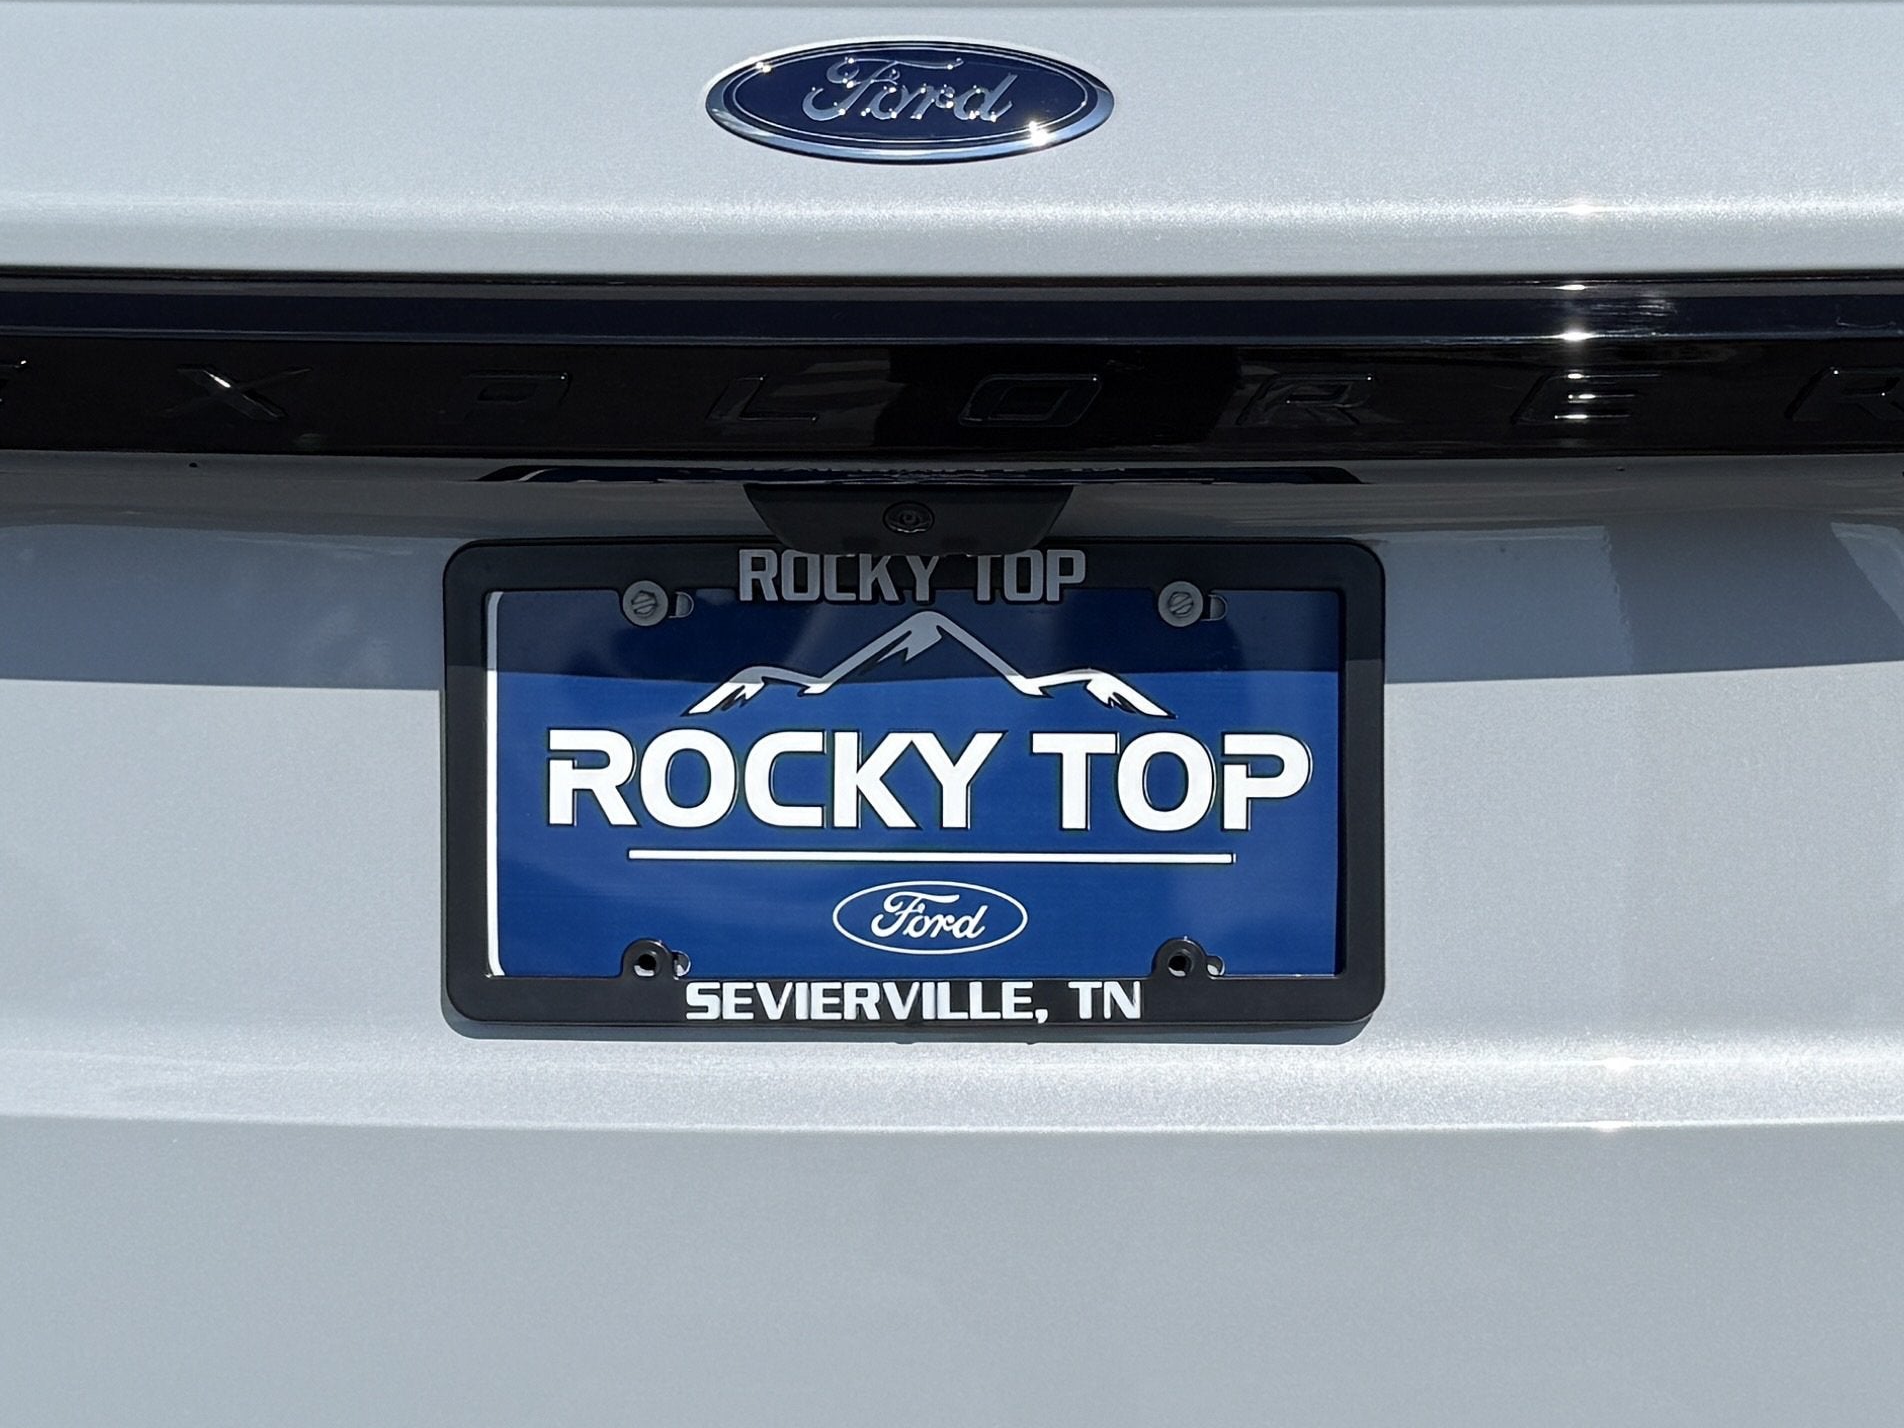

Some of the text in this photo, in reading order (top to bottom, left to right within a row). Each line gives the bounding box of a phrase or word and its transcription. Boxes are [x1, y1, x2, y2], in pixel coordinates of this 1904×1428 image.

[801, 58, 1015, 123] Ford
[739, 549, 1087, 601] ROCKY TOP
[547, 729, 1314, 833] ROCKY TOP
[870, 891, 988, 940] Ford
[686, 981, 1142, 1024] SEVIERVILLE, TN
